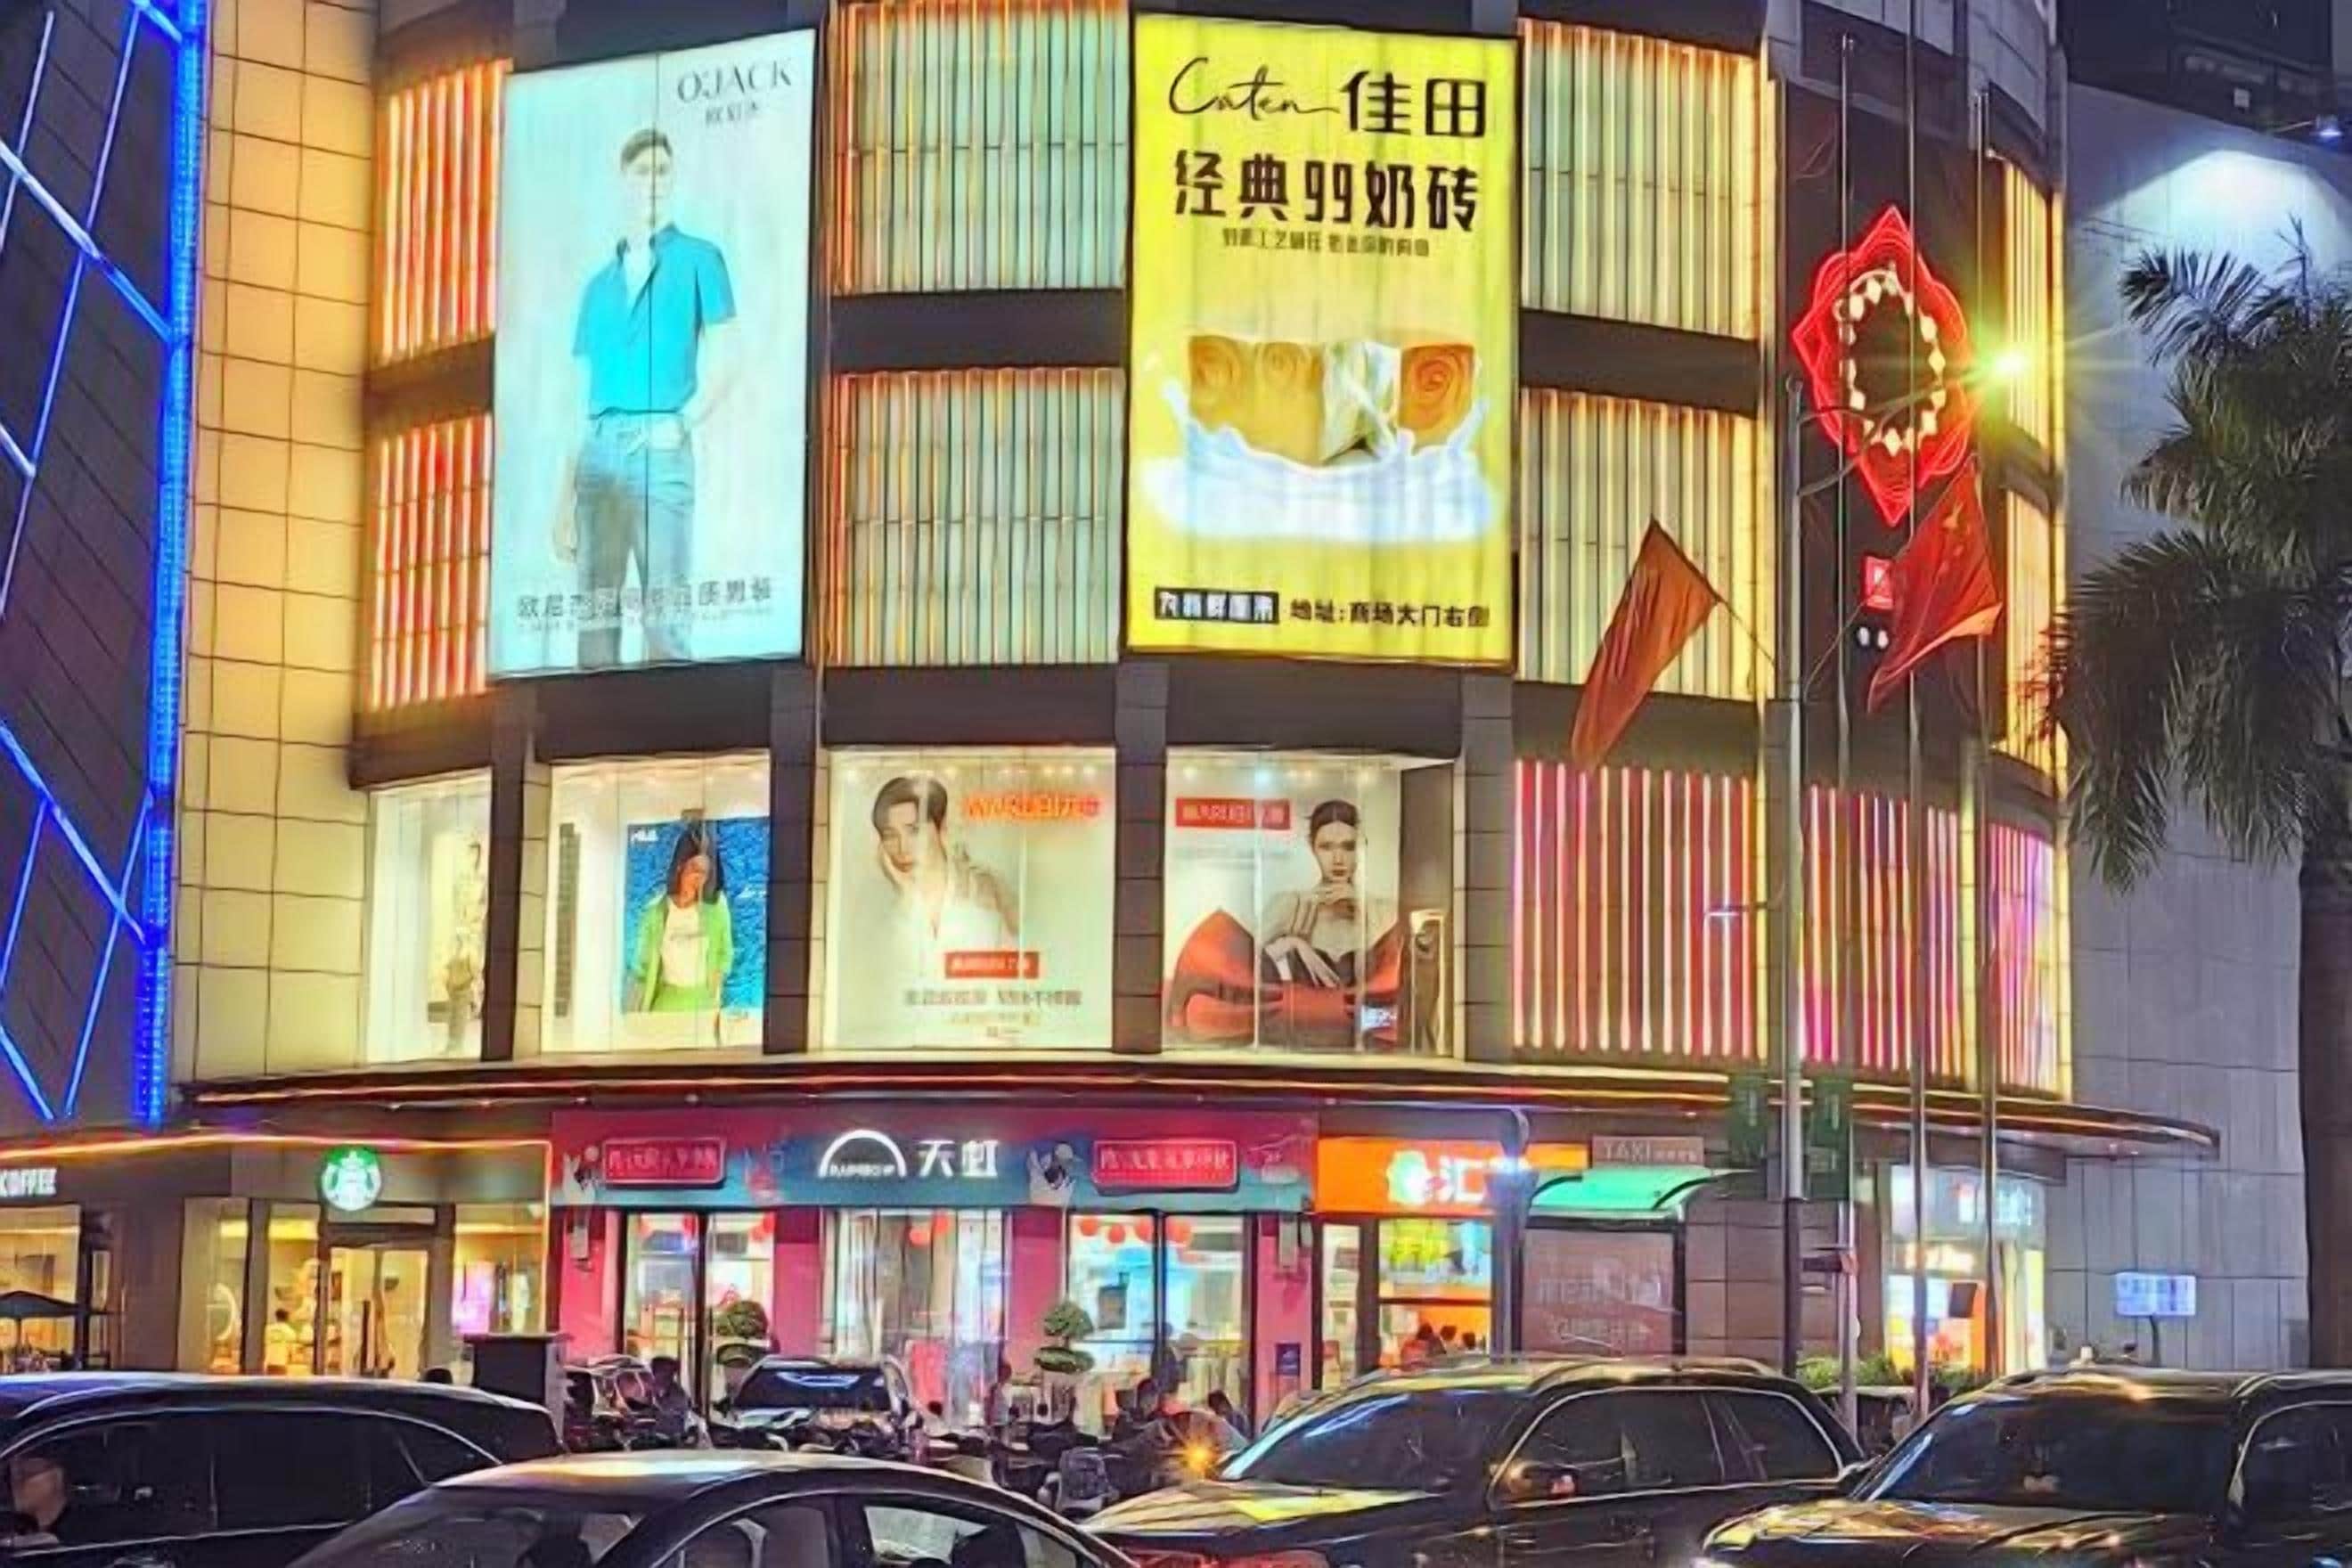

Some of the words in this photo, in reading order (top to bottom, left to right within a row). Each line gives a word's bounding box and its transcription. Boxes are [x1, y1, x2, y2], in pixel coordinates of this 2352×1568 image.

[1341, 69, 1487, 137] 佳田
[1173, 149, 1480, 233] 经典99奶砖
[918, 1139, 1000, 1179] 天虹
